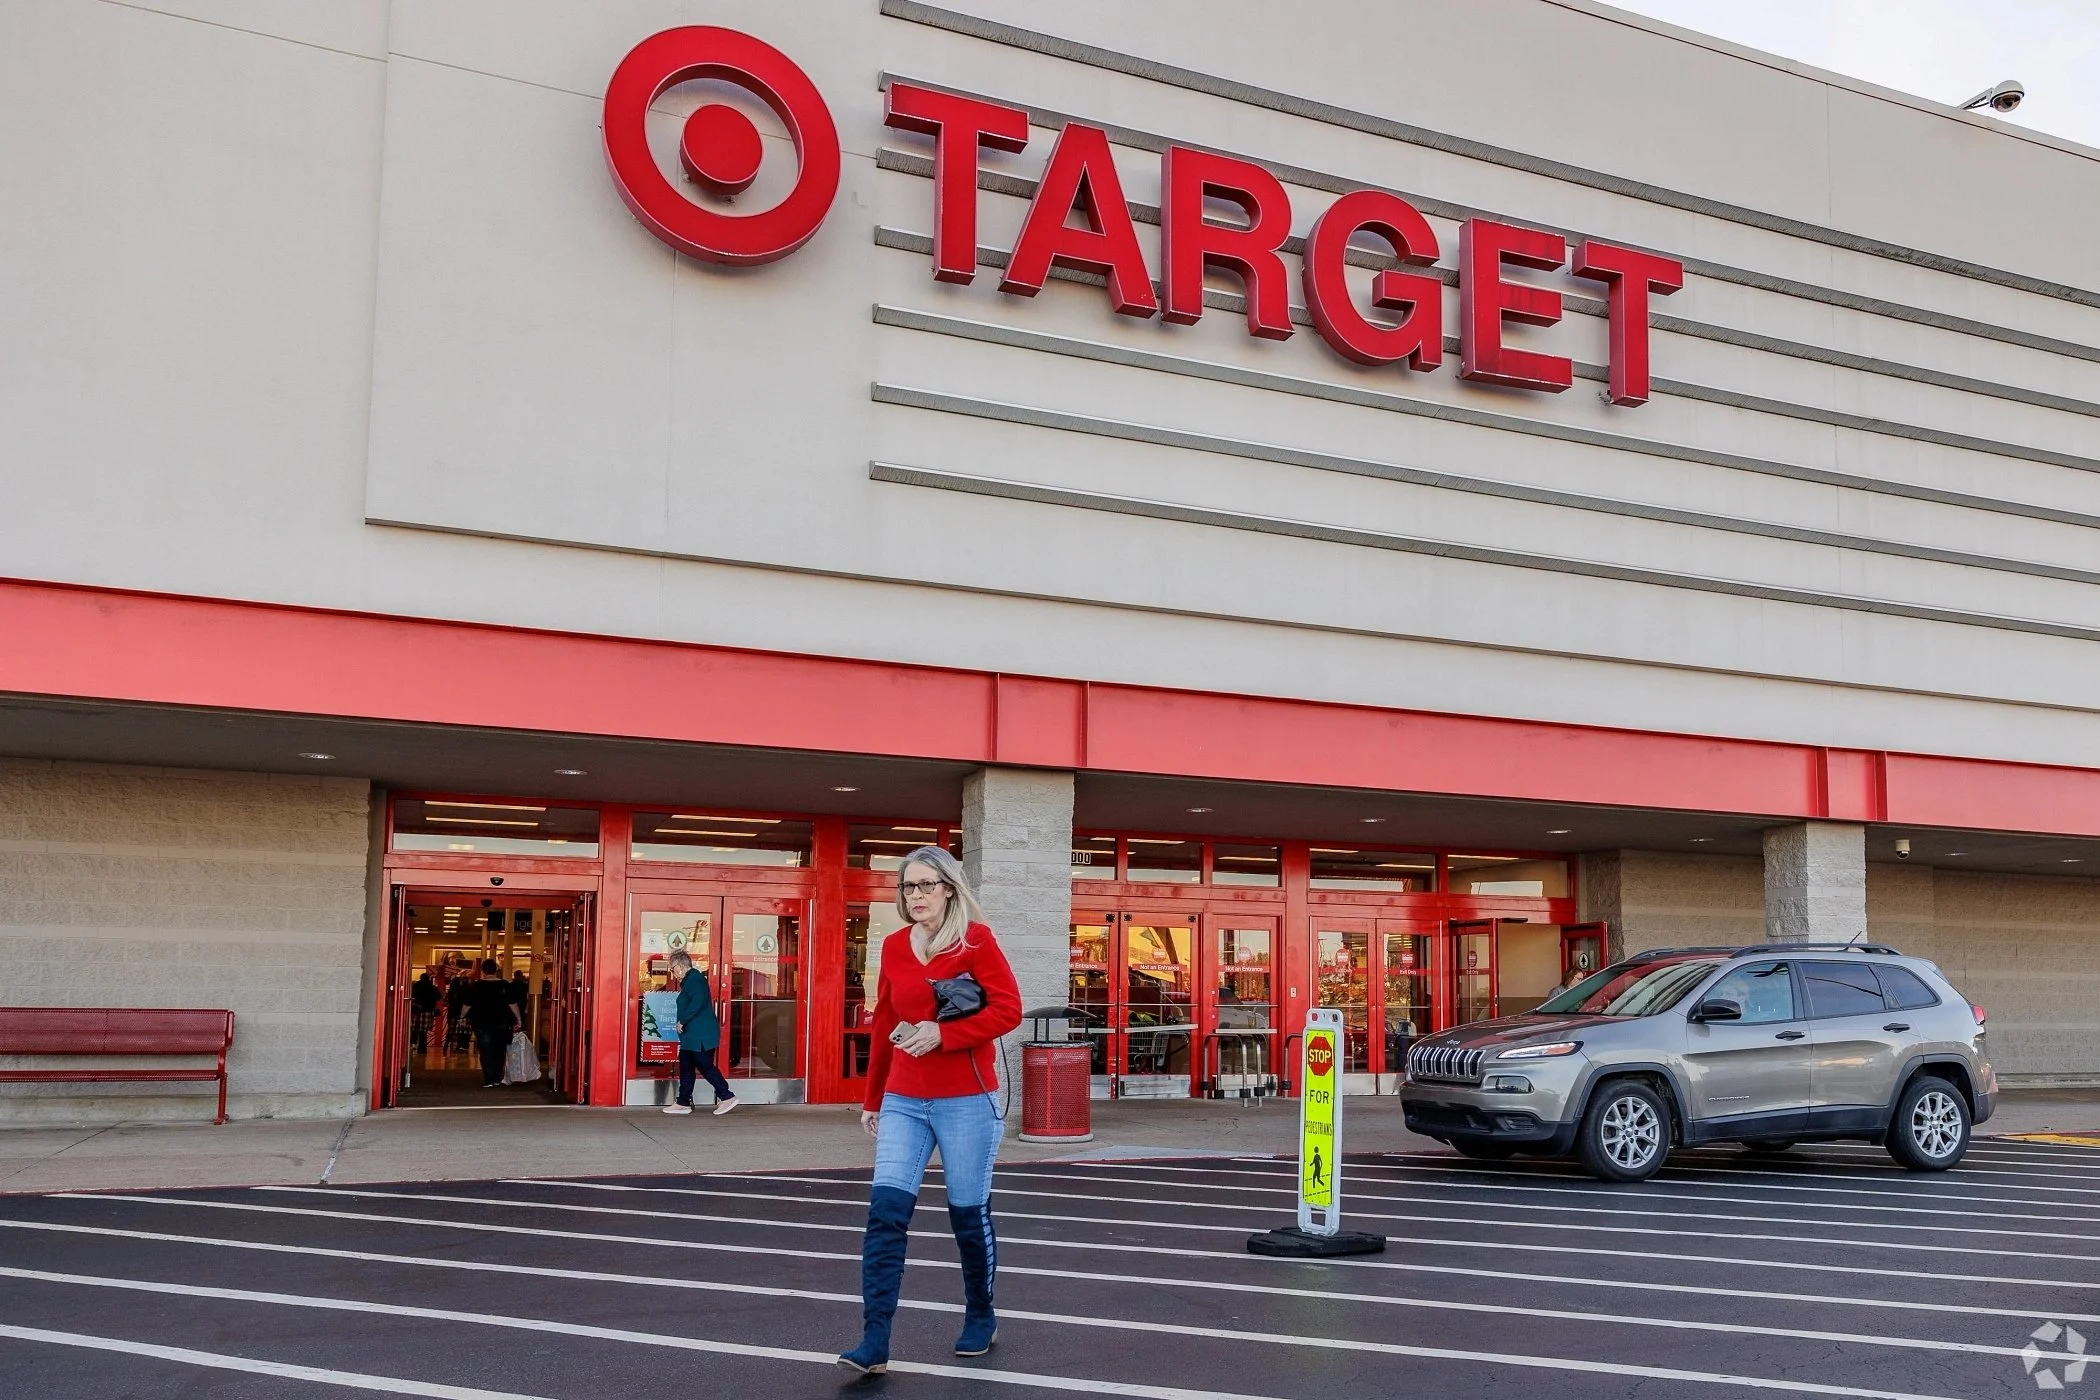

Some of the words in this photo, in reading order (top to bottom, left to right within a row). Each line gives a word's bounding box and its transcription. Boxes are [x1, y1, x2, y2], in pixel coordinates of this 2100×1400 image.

[883, 82, 1683, 408] TARGET
[659, 1014, 677, 1024] Targ
[1308, 1048, 1331, 1063] STOP
[1309, 1089, 1329, 1104] FOR
[1305, 1120, 1332, 1136] PEDESTRIANS
